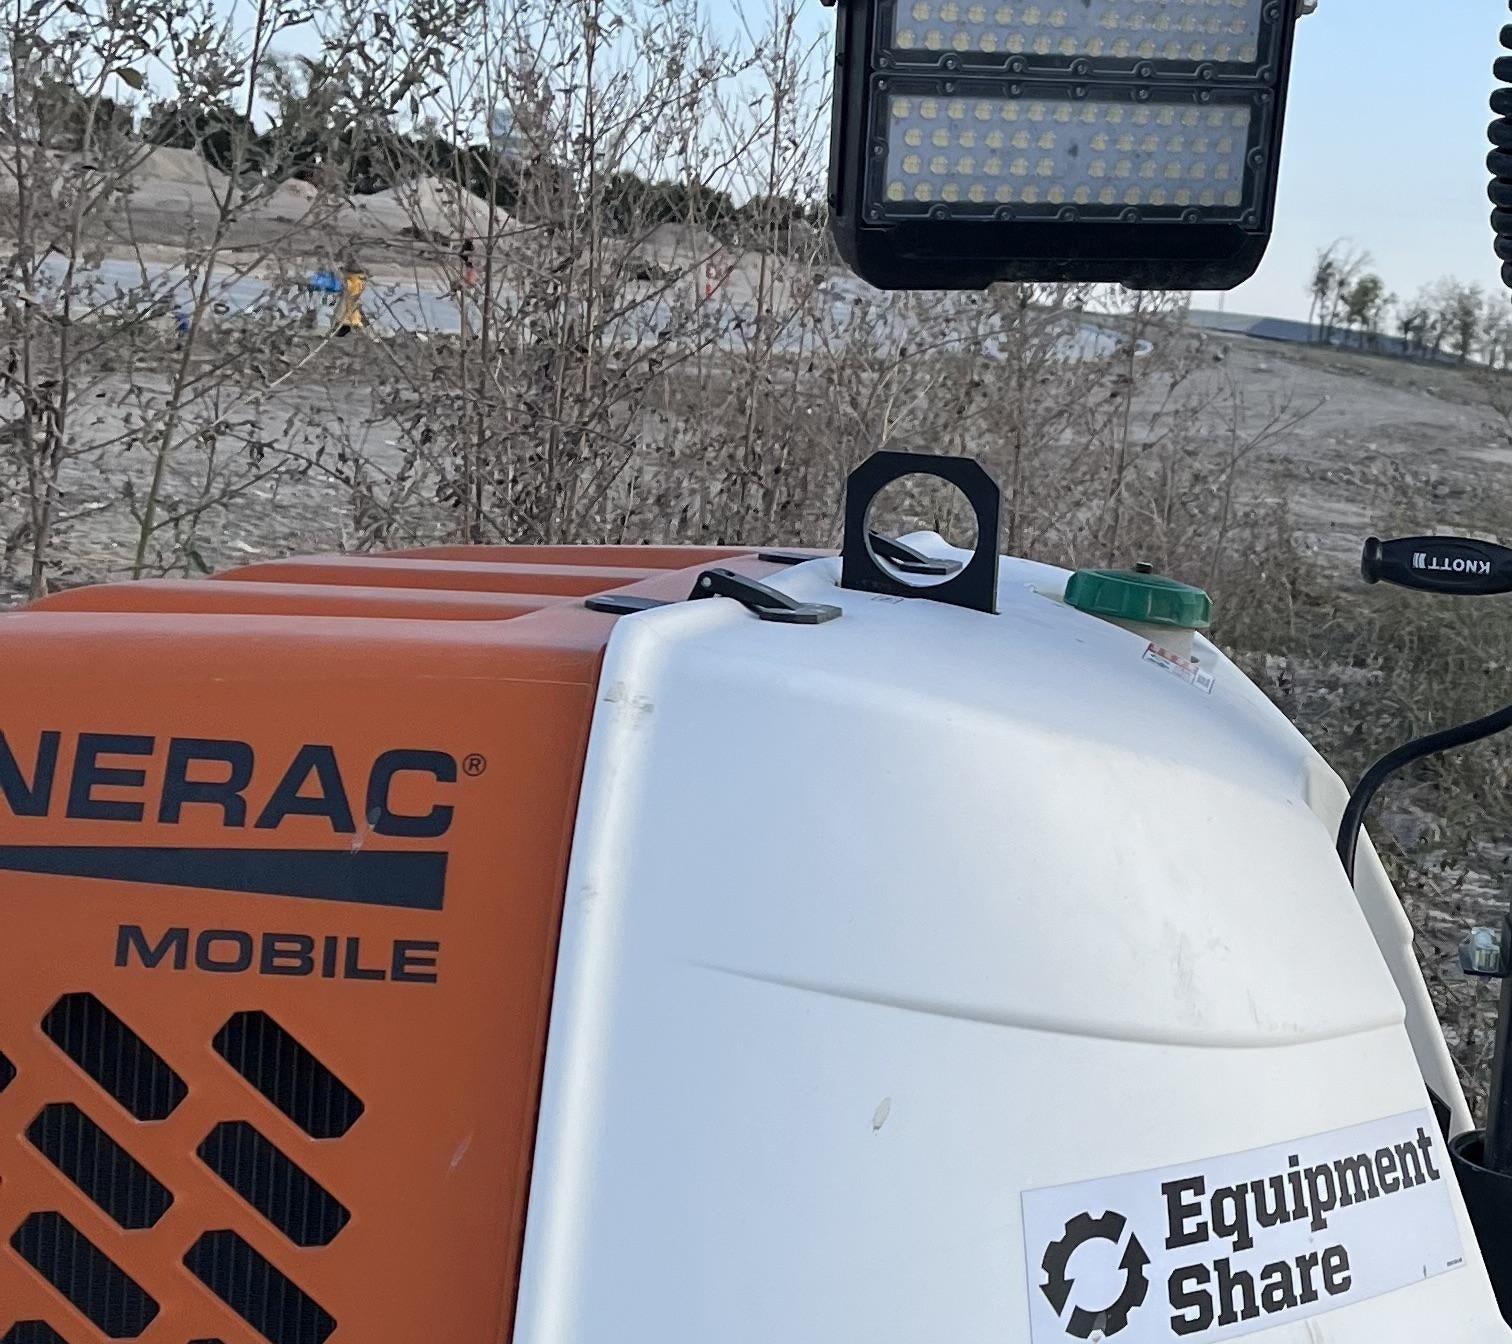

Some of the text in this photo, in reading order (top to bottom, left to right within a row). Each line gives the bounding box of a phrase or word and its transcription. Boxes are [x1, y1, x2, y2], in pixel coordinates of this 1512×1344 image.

[1428, 557, 1491, 575] KNOTT
[114, 924, 440, 984] MOBILE
[1161, 1127, 1440, 1252] Equipment
[1168, 1244, 1352, 1337] Share
